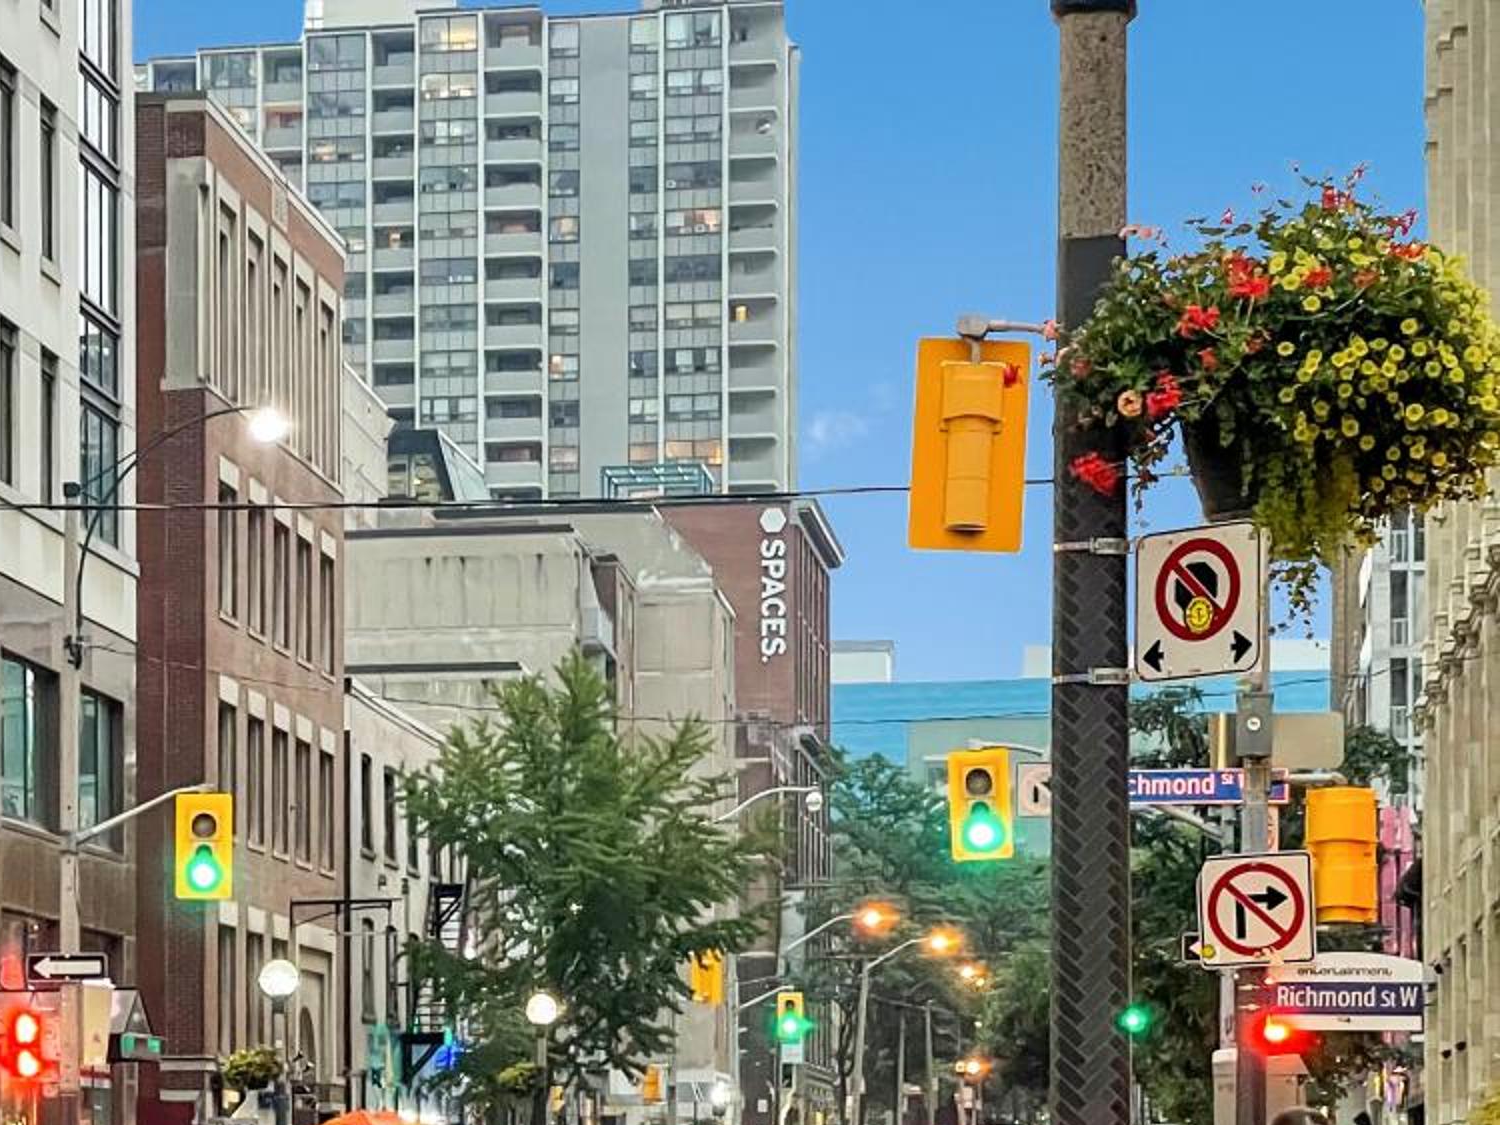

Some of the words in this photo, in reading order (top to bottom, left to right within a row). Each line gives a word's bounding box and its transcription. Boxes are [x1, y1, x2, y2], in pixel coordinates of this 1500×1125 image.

[1128, 774, 1215, 795] chmond
[1221, 774, 1234, 785] St
[1277, 986, 1375, 1007] Richmond
[1381, 992, 1396, 1006] St
[1401, 986, 1418, 1007] W
